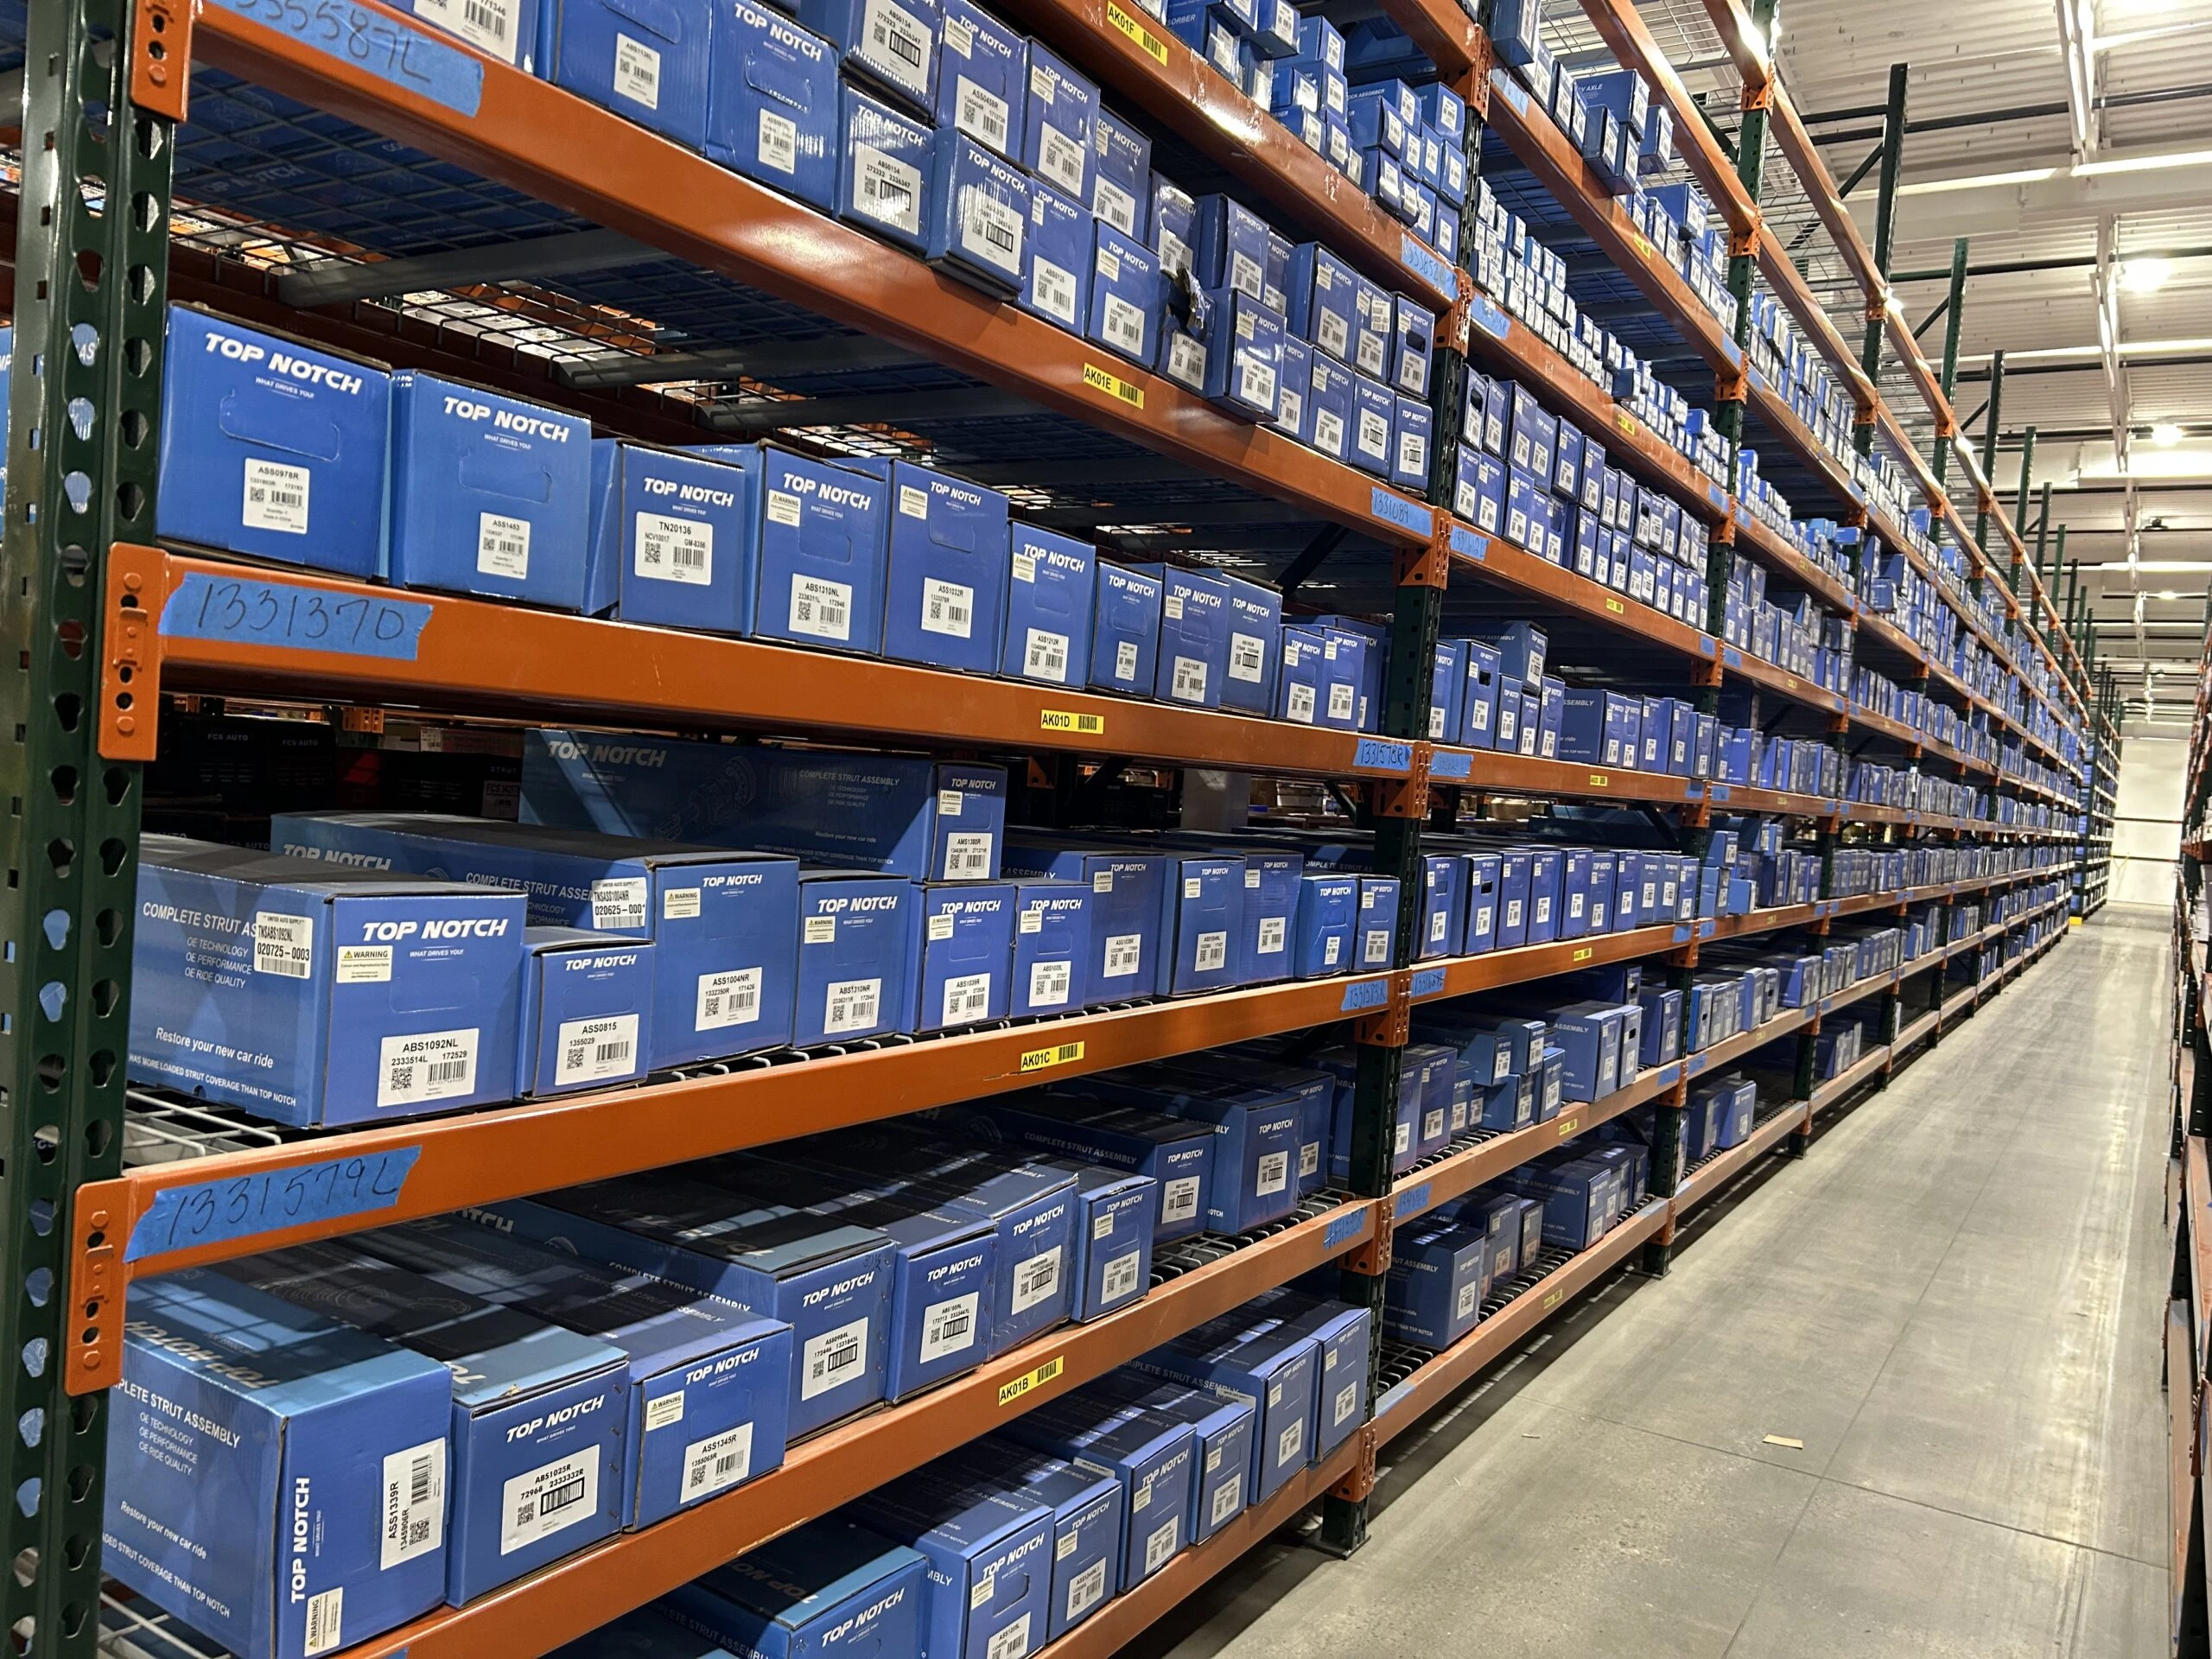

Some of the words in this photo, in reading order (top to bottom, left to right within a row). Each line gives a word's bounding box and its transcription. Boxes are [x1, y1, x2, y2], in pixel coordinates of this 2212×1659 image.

[735, 3, 767, 29] TOP
[769, 22, 823, 62] NOTCH
[1109, 6, 1135, 35] AK01F
[959, 15, 979, 35] TOP
[979, 28, 1012, 59] NOTCH
[1245, 308, 1260, 324] TOP
[1259, 316, 1279, 334] NOTCH
[206, 332, 265, 362] TOP
[268, 353, 364, 395] NOTCH
[1084, 367, 1111, 390] AK01E
[443, 397, 491, 422] TOP
[494, 410, 570, 443] NOTCH
[644, 477, 677, 496] TOP
[679, 484, 734, 508] NOTCH
[778, 497, 799, 507] WARNING
[783, 473, 817, 495] TOP
[820, 483, 872, 512] NOTCH
[931, 481, 950, 495] TOP
[950, 488, 982, 506] NOTCH
[1375, 495, 1409, 524] 1331089
[493, 519, 521, 531] ASS1453
[645, 531, 670, 543] NCV10017
[658, 520, 692, 536] TN20136
[1023, 543, 1046, 560] TOP
[1047, 551, 1085, 573] NOTCH
[805, 582, 840, 598] ABS1310NL
[938, 584, 963, 598] ASS1032R
[198, 583, 405, 645] 1331370
[1291, 639, 1302, 650] TOP
[1302, 644, 1321, 657] NOTCH
[1042, 713, 1071, 728] AK01D
[1361, 742, 1403, 766] 1331578R
[1110, 862, 1124, 873] TOP
[1124, 863, 1147, 873] NOTCH
[465, 871, 521, 892] COMPLETE
[523, 880, 557, 898] STRUT
[702, 876, 726, 888] TOP
[726, 874, 763, 886] NOTCH
[817, 898, 849, 913] TOP
[849, 895, 899, 912] NOTCH
[941, 901, 963, 914] TOP
[964, 899, 1001, 913] NOTCH
[1031, 899, 1051, 911] TOP
[1051, 899, 1083, 910] NOTCH
[143, 901, 201, 929] COMPLETE
[203, 913, 242, 934] STRUT
[363, 921, 418, 942] TOP
[422, 918, 508, 940] NOTCH
[257, 925, 293, 943] TNSABS1092NL
[187, 937, 198, 948] OE
[200, 938, 250, 958] TECHNOLOGY
[353, 950, 389, 959] WARNING
[186, 952, 196, 963] OE
[197, 954, 252, 976] PERFORMANCE
[565, 958, 592, 971] TOP
[594, 954, 638, 968] NOTCH
[184, 968, 195, 979] OE
[196, 969, 213, 982] RIDE
[213, 973, 246, 988] QUALITY
[712, 974, 750, 987] ASS1004NR
[839, 983, 871, 995] ABS1310NR
[582, 1021, 618, 1035] ASS0815
[156, 1027, 191, 1048] Restore
[191, 1037, 214, 1055] your
[215, 1044, 235, 1059] new
[236, 1049, 253, 1063] car
[254, 1051, 274, 1069] ride
[403, 1039, 459, 1053] ABS1092NL
[569, 1037, 595, 1047] 1355029
[391, 1054, 428, 1066] 2333514L
[442, 1050, 467, 1060] 172529
[1021, 1051, 1051, 1069] AK01C
[142, 1056, 159, 1070] MORE
[160, 1061, 185, 1077] LOADED
[185, 1067, 205, 1083] STRUT
[205, 1072, 240, 1092] COVERAGE
[240, 1083, 258, 1097] THAN
[258, 1088, 273, 1100] TOP
[273, 1091, 296, 1108] NOTCH
[1066, 1141, 1092, 1156] STRUT
[1092, 1146, 1137, 1166] ASSEMBLY
[1166, 1153, 1182, 1164] TOP
[1182, 1148, 1204, 1161] NOTCH
[168, 1156, 398, 1246] 1331579L
[1013, 1221, 1033, 1237] TOP
[1032, 1204, 1065, 1230] NOTCH
[927, 1268, 947, 1282] TOP
[947, 1254, 983, 1277] NOTCH
[802, 1287, 830, 1308] TOP
[830, 1271, 874, 1300] NOTCH
[124, 1321, 224, 1366] NOTCH
[825, 1332, 849, 1346] ASS0984L
[205, 1362, 279, 1389] TOP
[685, 1368, 715, 1386] TOP
[714, 1347, 760, 1376] NOTCH
[657, 1395, 682, 1408] WARNING
[1000, 1377, 1029, 1403] AK01B
[139, 1412, 149, 1424] OE
[150, 1415, 194, 1446] TECHNOLOGY
[150, 1394, 185, 1421] STRUT
[184, 1410, 241, 1449] ASSEMBLY
[506, 1420, 541, 1443] TOP
[545, 1394, 606, 1429] NOTCH
[138, 1427, 149, 1439] OE
[149, 1431, 199, 1464] PERFORMANCE
[702, 1433, 738, 1454] ASS1345R
[138, 1441, 149, 1453] OE
[149, 1446, 163, 1461] RIDE
[163, 1452, 193, 1476] QUALITY
[1141, 1470, 1161, 1486] TOP
[1160, 1447, 1189, 1476] NOTCH
[520, 1484, 543, 1501] 72968
[549, 1467, 585, 1489] 2333332R
[535, 1463, 571, 1484] ABS1025R
[293, 1477, 311, 1553] NOTCH
[388, 1480, 400, 1539] ASS1339R
[120, 1500, 147, 1525] Restore
[146, 1516, 162, 1537] your
[163, 1527, 178, 1543] new
[179, 1535, 192, 1549] car
[192, 1539, 207, 1560] ride
[400, 1508, 410, 1551] 1345906R
[982, 1559, 1008, 1580] TOP
[1007, 1532, 1046, 1566] NOTCH
[117, 1539, 138, 1562] STRUT
[137, 1553, 173, 1584] COVERAGE
[173, 1575, 192, 1596] THAN
[192, 1585, 207, 1603] TOP
[206, 1594, 231, 1618] NOTCH
[290, 1558, 308, 1604] TOP
[309, 1599, 320, 1639] WARNING
[821, 1618, 859, 1648] TOP
[860, 1587, 906, 1623] NOTCH
